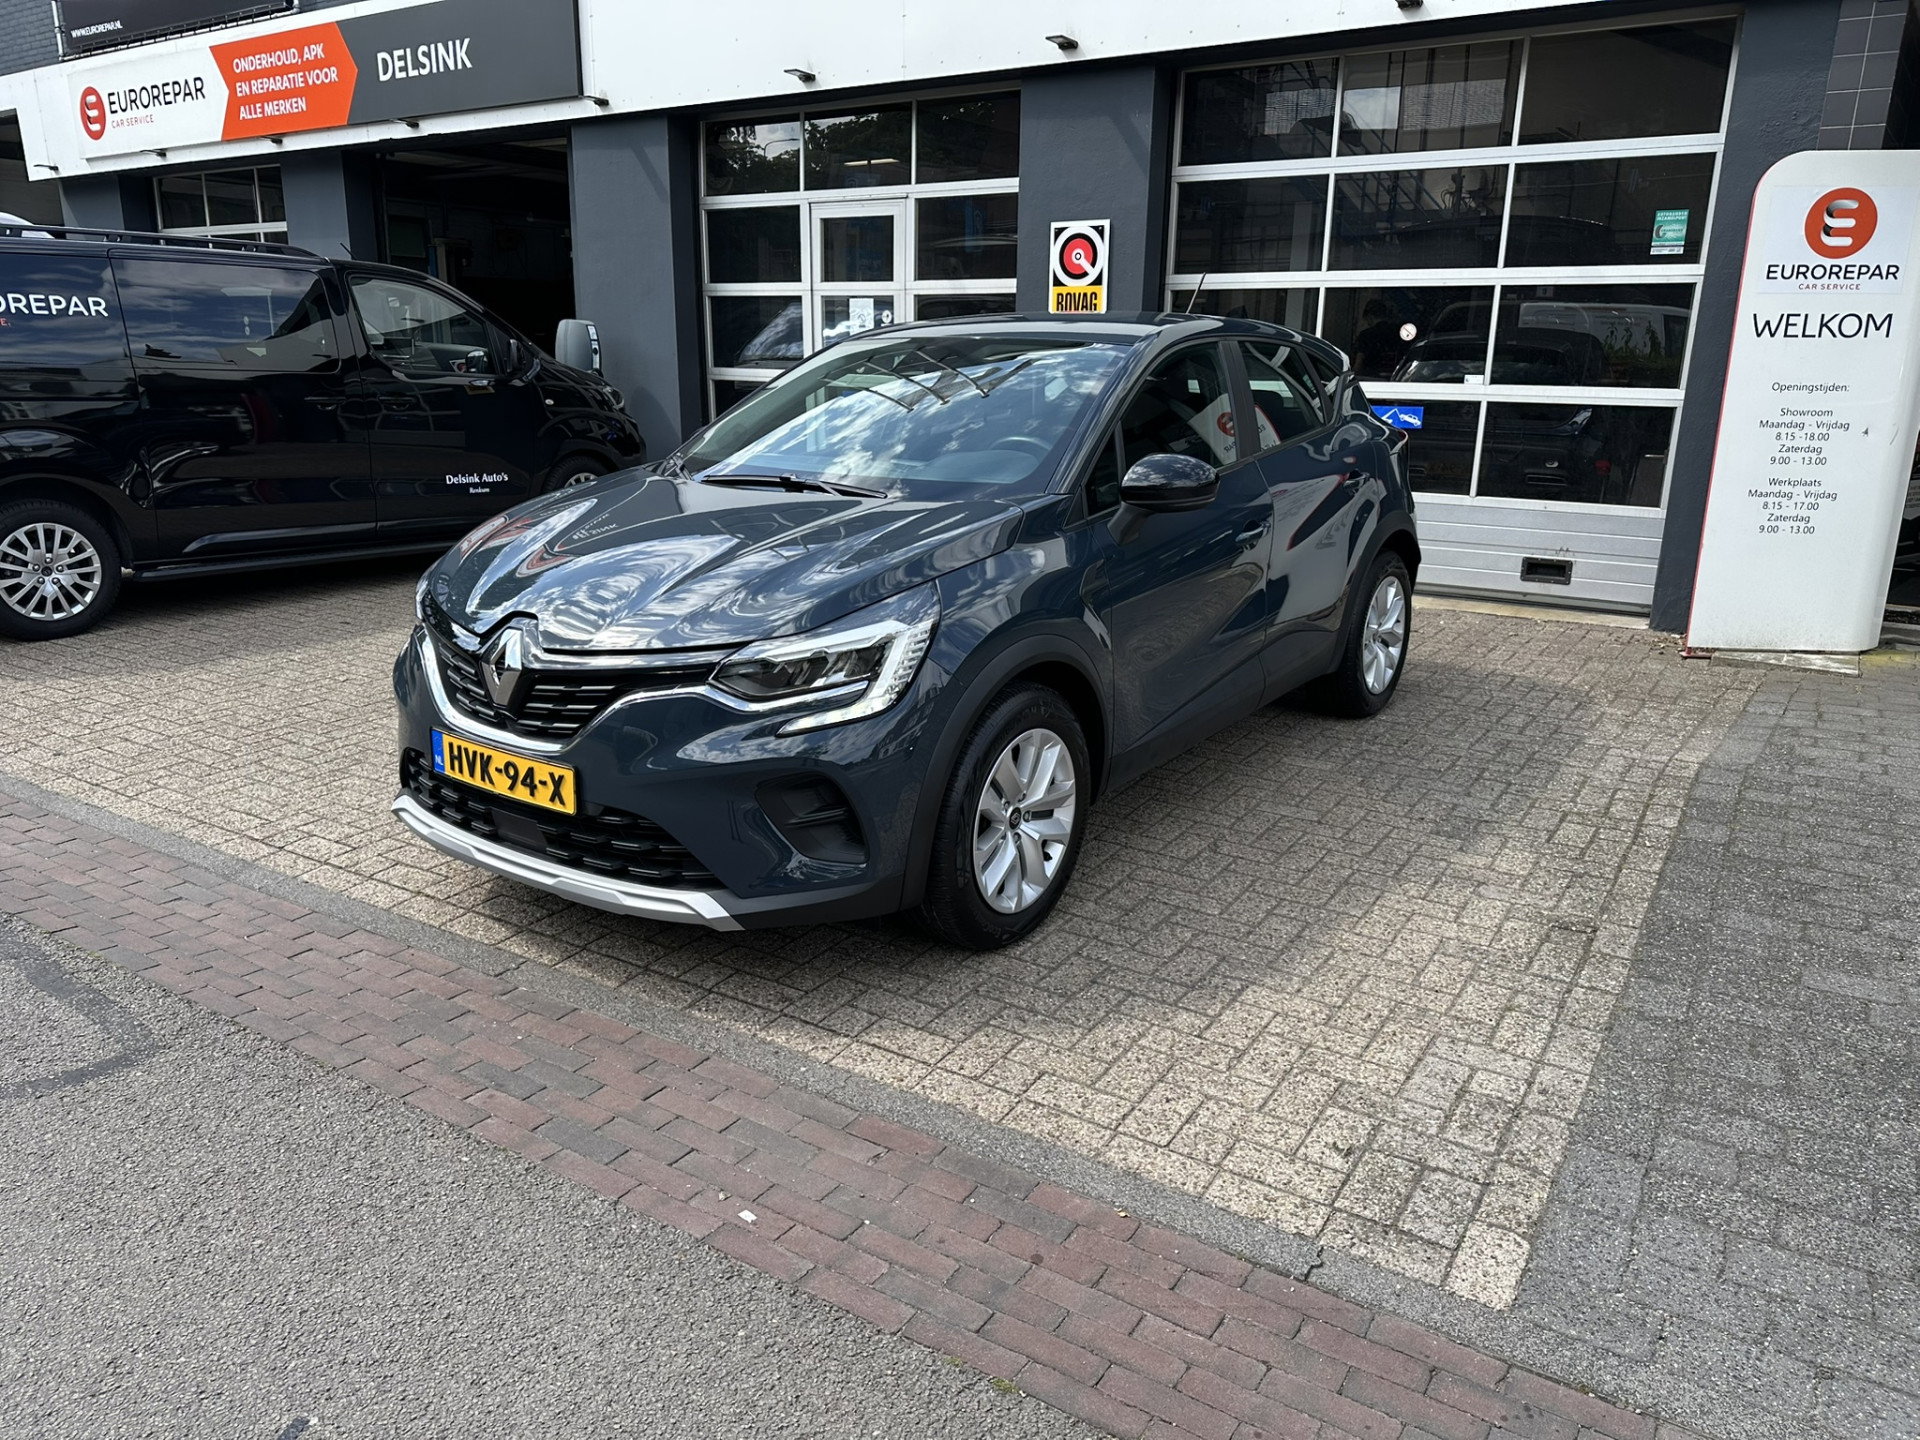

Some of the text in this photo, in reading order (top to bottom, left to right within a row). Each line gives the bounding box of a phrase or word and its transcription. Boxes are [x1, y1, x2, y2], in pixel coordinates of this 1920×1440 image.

[232, 43, 325, 74] ONDERHOUD, APK
[376, 37, 473, 82] DELSINK
[235, 66, 339, 97] EN REPARATIE VOOR
[107, 76, 206, 114] EUROREPAR
[239, 96, 307, 121] ALLE MERKEN
[111, 114, 154, 129] CAR SERVICE
[1766, 264, 1900, 280] EUROREPAR
[1798, 283, 1861, 291] CAR SERVICE
[1056, 291, 1098, 312] BOVAG
[1753, 313, 1893, 338] WELKOM
[1771, 382, 1850, 394] Openingstijden:
[1780, 407, 1833, 417] Showroom
[1759, 419, 1805, 431] Maandag
[1816, 420, 1850, 432] Vrijdag
[1775, 432, 1796, 441] 8.15
[1778, 444, 1823, 455] Zaterdag
[1770, 456, 1791, 465] 9.00
[1801, 456, 1827, 465] 13.00
[445, 472, 509, 485] Delsink Auto's
[1768, 478, 1822, 488] Werkplaats
[1748, 489, 1793, 501] Maandag
[1804, 490, 1838, 501] Vrijdag
[1762, 501, 1783, 510] 8.15
[1793, 502, 1820, 511] 17.00
[1767, 513, 1811, 524] Zaterdag
[1759, 525, 1779, 534] 9.00
[1789, 526, 1815, 535] 13.00
[434, 754, 444, 766] NL
[448, 741, 566, 807] HVK-94-X
